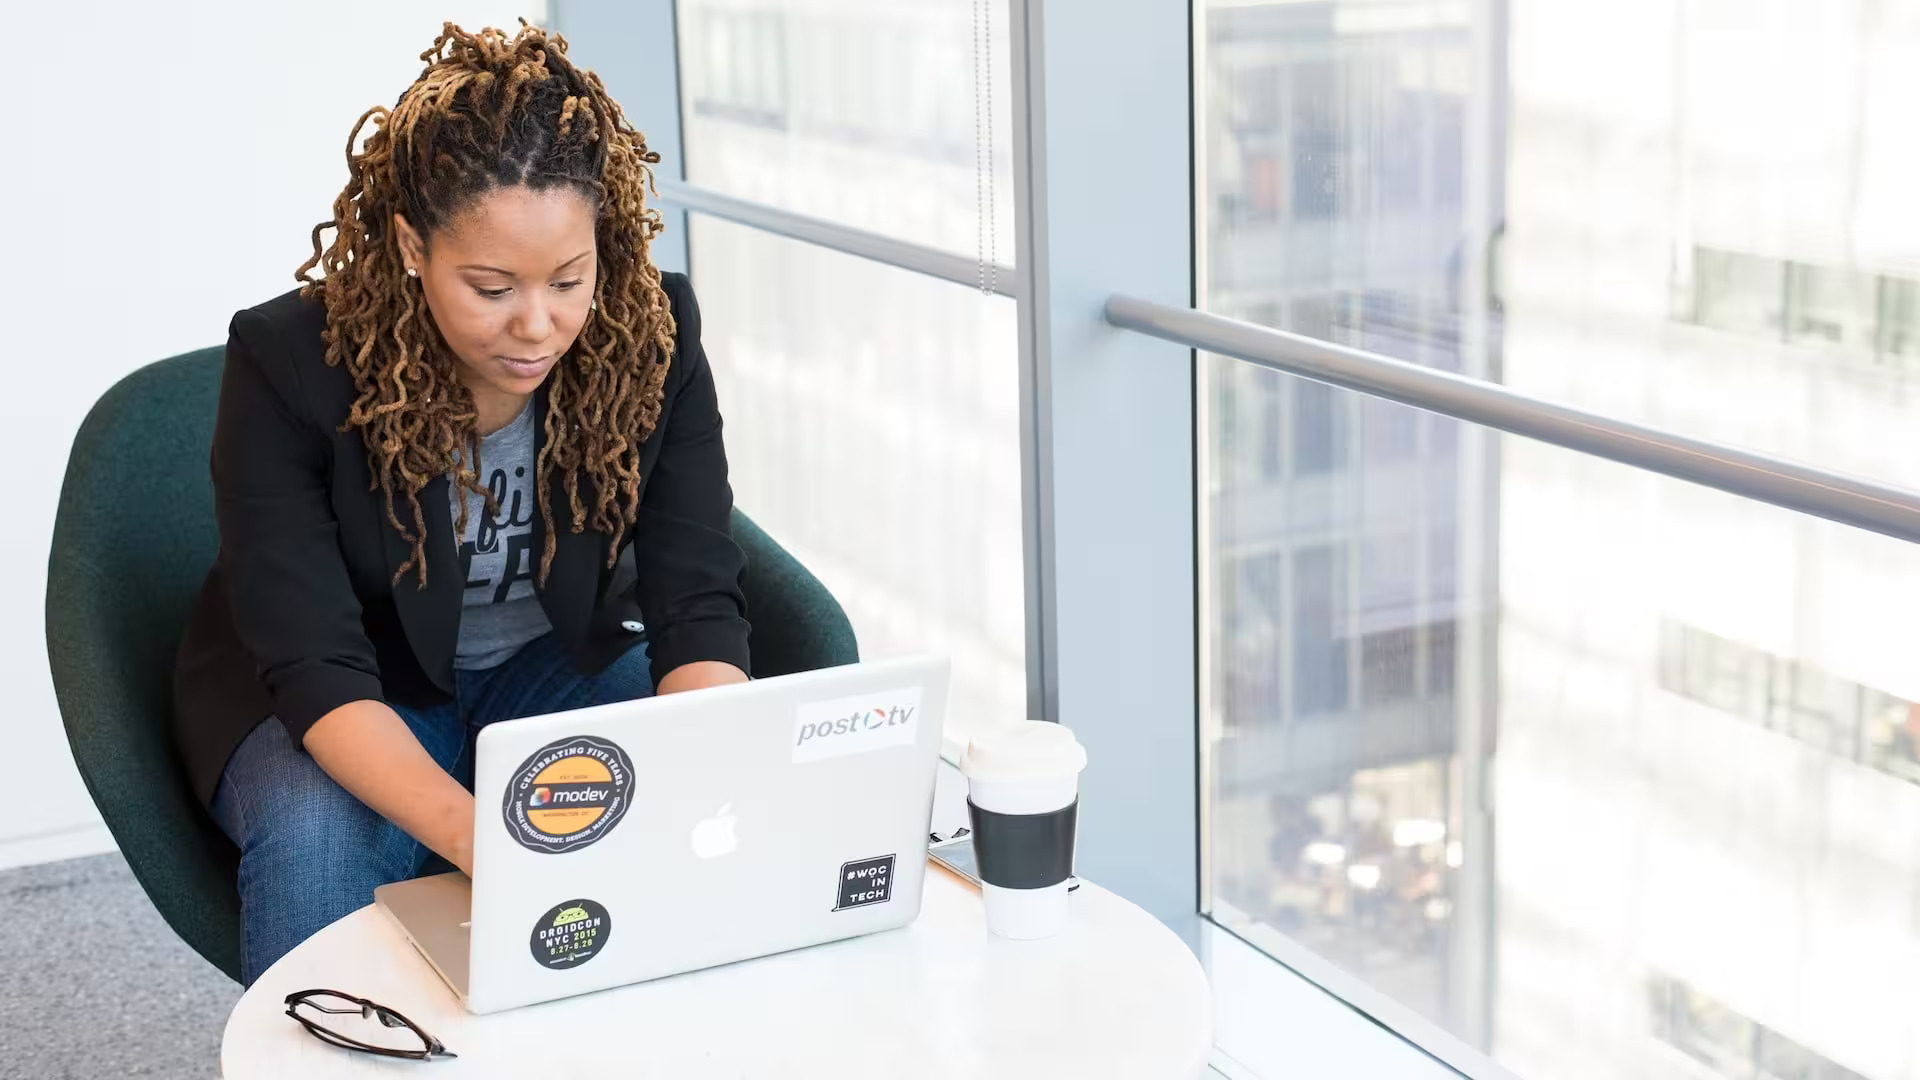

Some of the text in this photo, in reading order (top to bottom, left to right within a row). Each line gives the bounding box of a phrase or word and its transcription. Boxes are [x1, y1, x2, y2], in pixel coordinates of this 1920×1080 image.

[797, 705, 914, 746] post tv
[520, 747, 624, 790] CELEBRATING FIVE YEARS
[553, 787, 609, 803] modev
[515, 801, 525, 824] MOBILE
[593, 796, 621, 831] MARKETING
[847, 865, 887, 880] #WOC
[872, 877, 886, 887] IN
[850, 889, 884, 902] TECH
[540, 917, 601, 939] DROIDCON
[546, 928, 597, 948] NYC 2015
